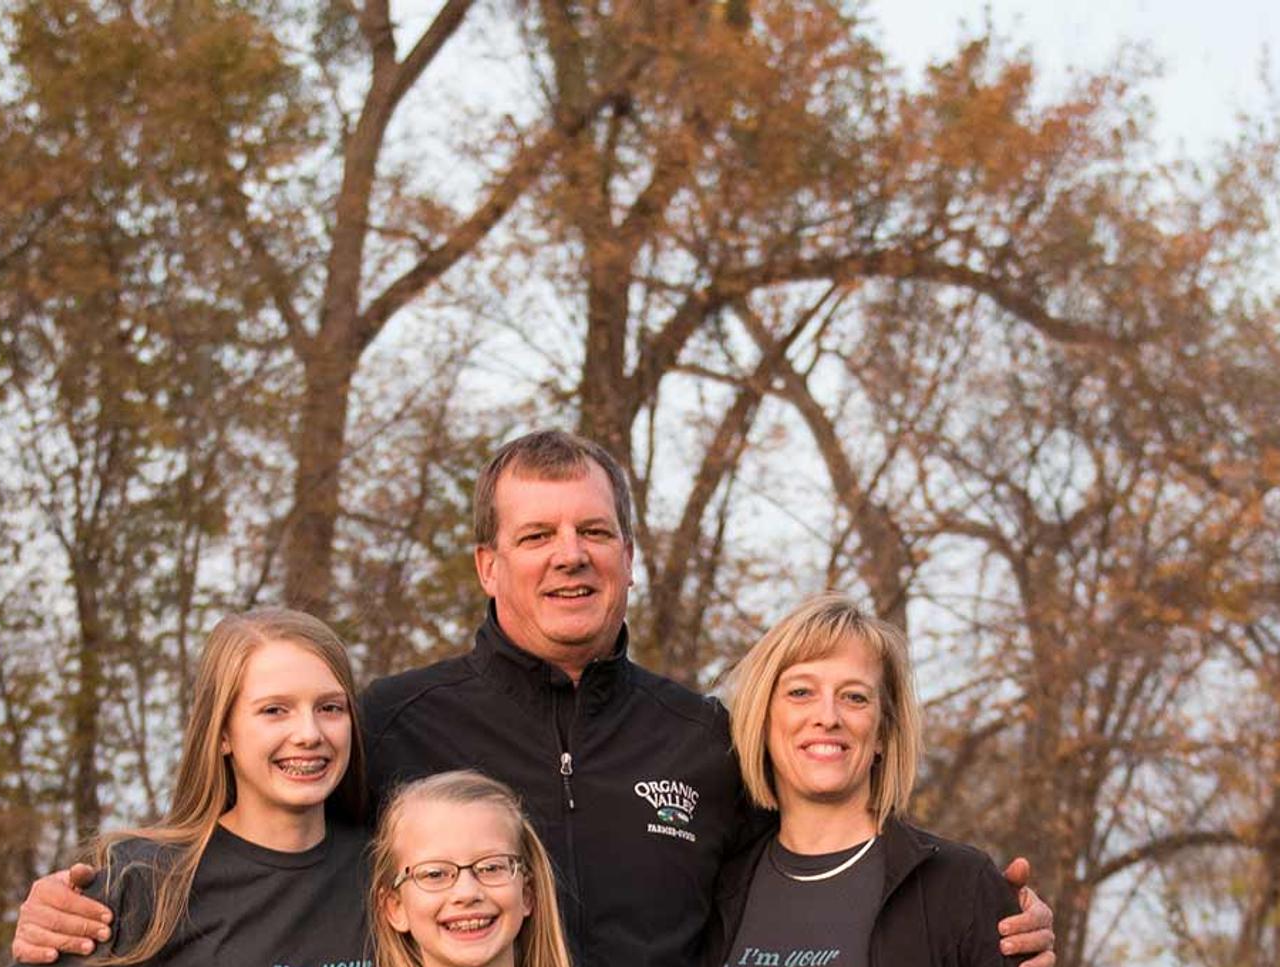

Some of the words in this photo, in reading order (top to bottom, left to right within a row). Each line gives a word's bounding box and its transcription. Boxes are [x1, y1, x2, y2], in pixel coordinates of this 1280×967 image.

[634, 780, 699, 805] ORGANIC
[646, 793, 695, 815] VALLEY
[738, 948, 780, 966] I'm
